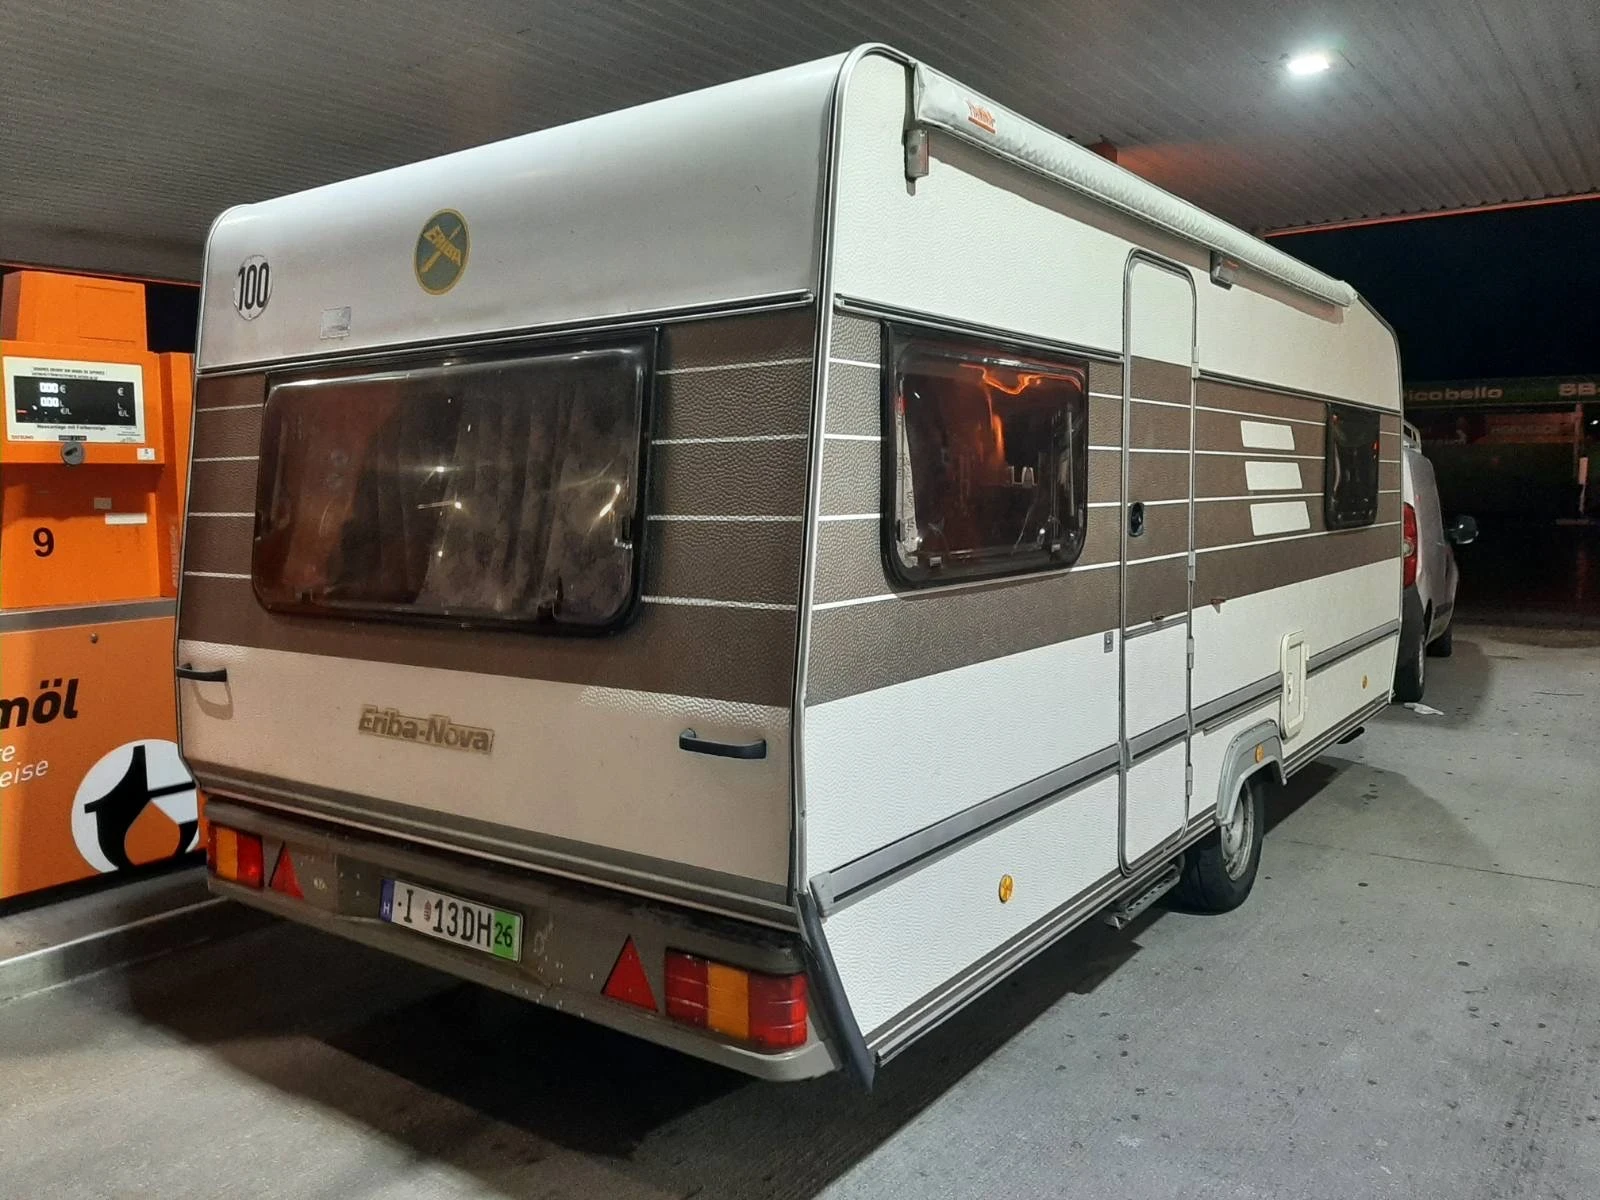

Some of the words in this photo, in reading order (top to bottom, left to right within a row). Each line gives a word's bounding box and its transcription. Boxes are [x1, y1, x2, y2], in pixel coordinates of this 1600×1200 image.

[238, 262, 270, 311] 100
[1404, 386, 1503, 401] icobello
[33, 527, 54, 557] 9
[358, 706, 491, 752] Eriba-Nova
[383, 903, 390, 914] H
[433, 898, 492, 948] 13DH
[494, 922, 513, 947] 26
